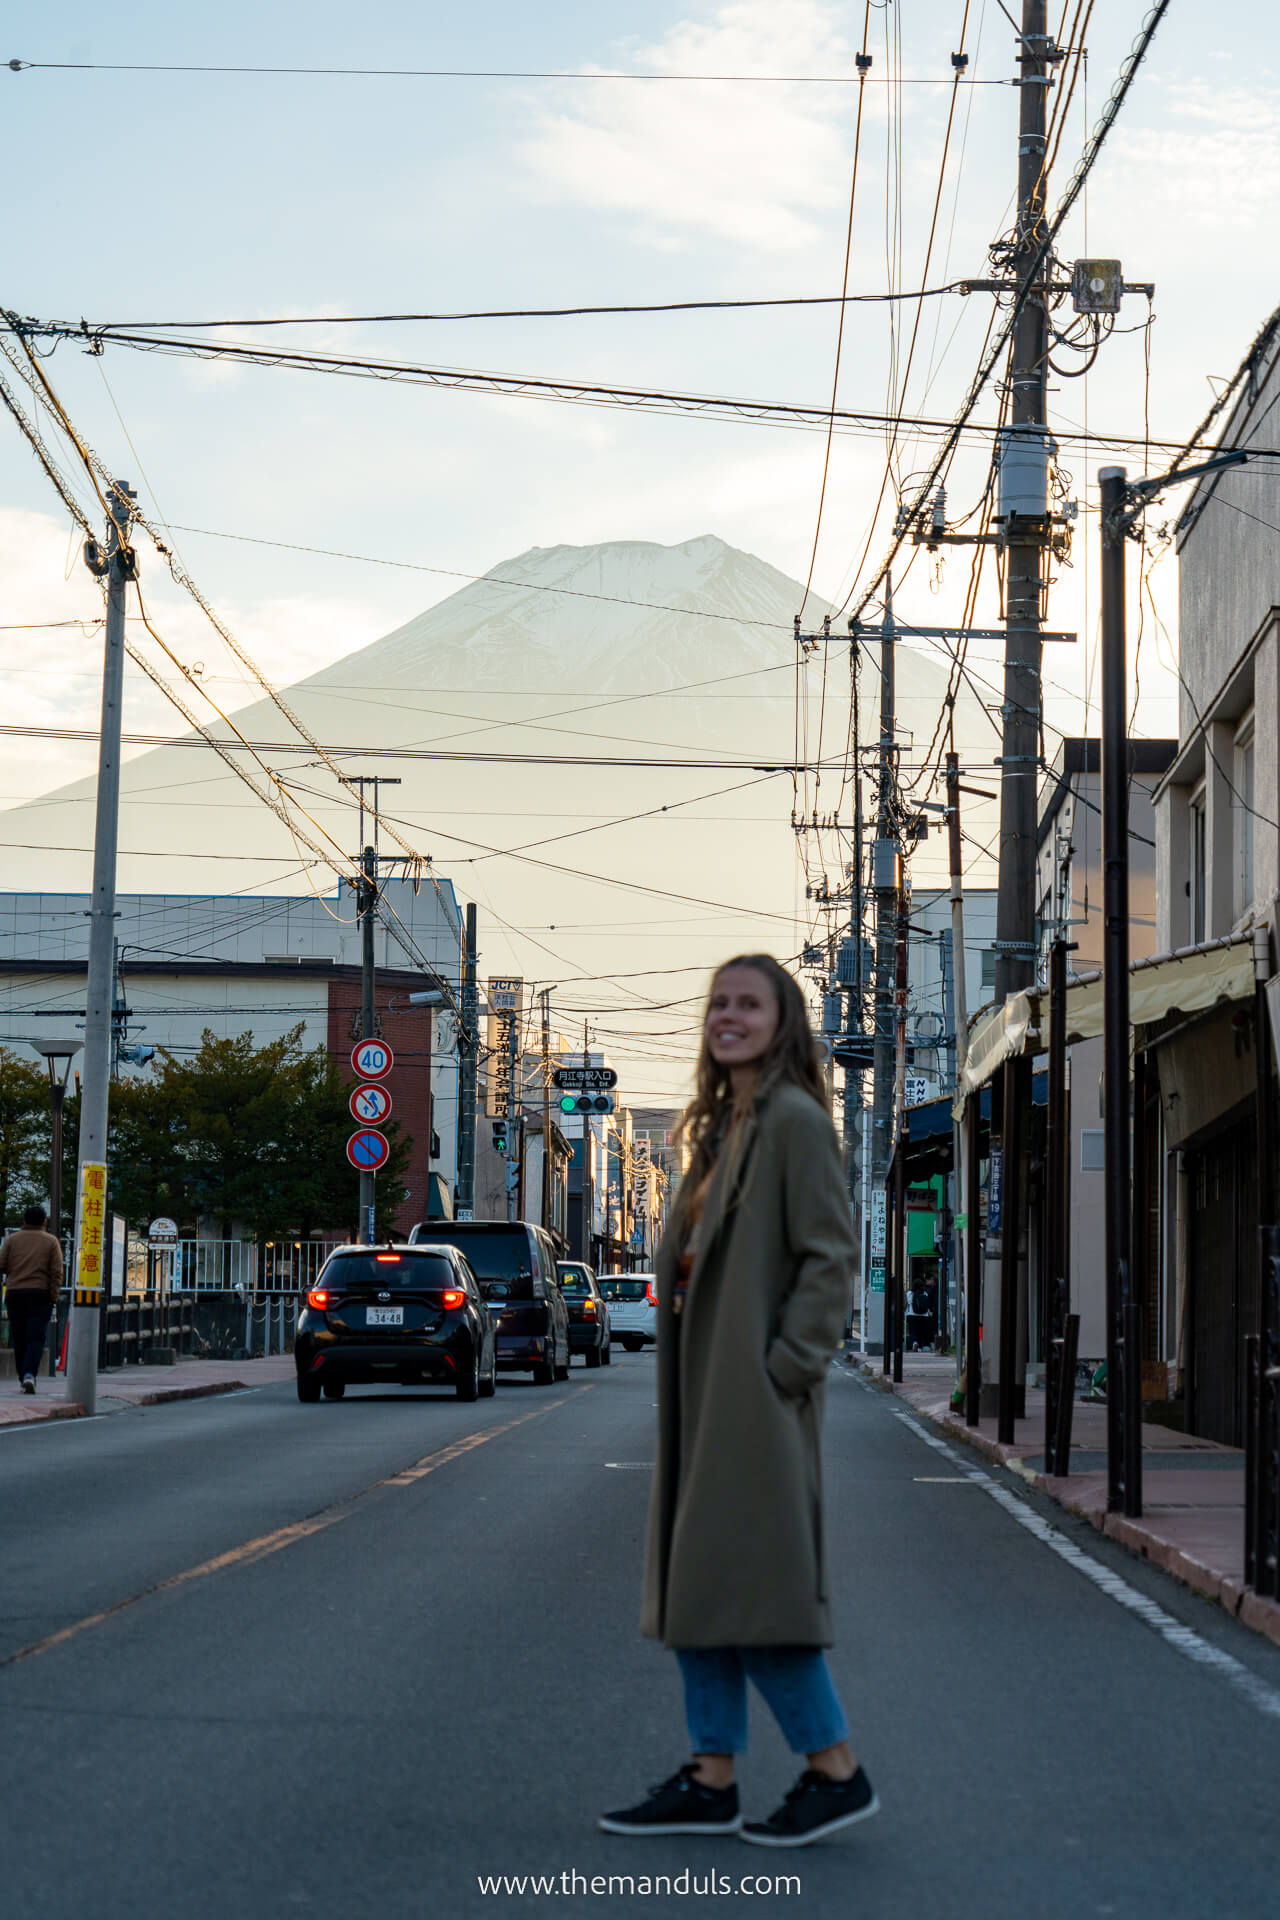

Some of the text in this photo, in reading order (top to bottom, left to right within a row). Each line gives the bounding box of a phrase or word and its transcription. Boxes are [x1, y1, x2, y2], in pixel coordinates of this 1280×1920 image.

[492, 980, 511, 990] JCI
[361, 1050, 384, 1069] 40
[559, 1071, 611, 1081] 月江寺駅入口
[991, 1203, 1000, 1213] 19
[82, 1170, 104, 1273] 電柱注意
